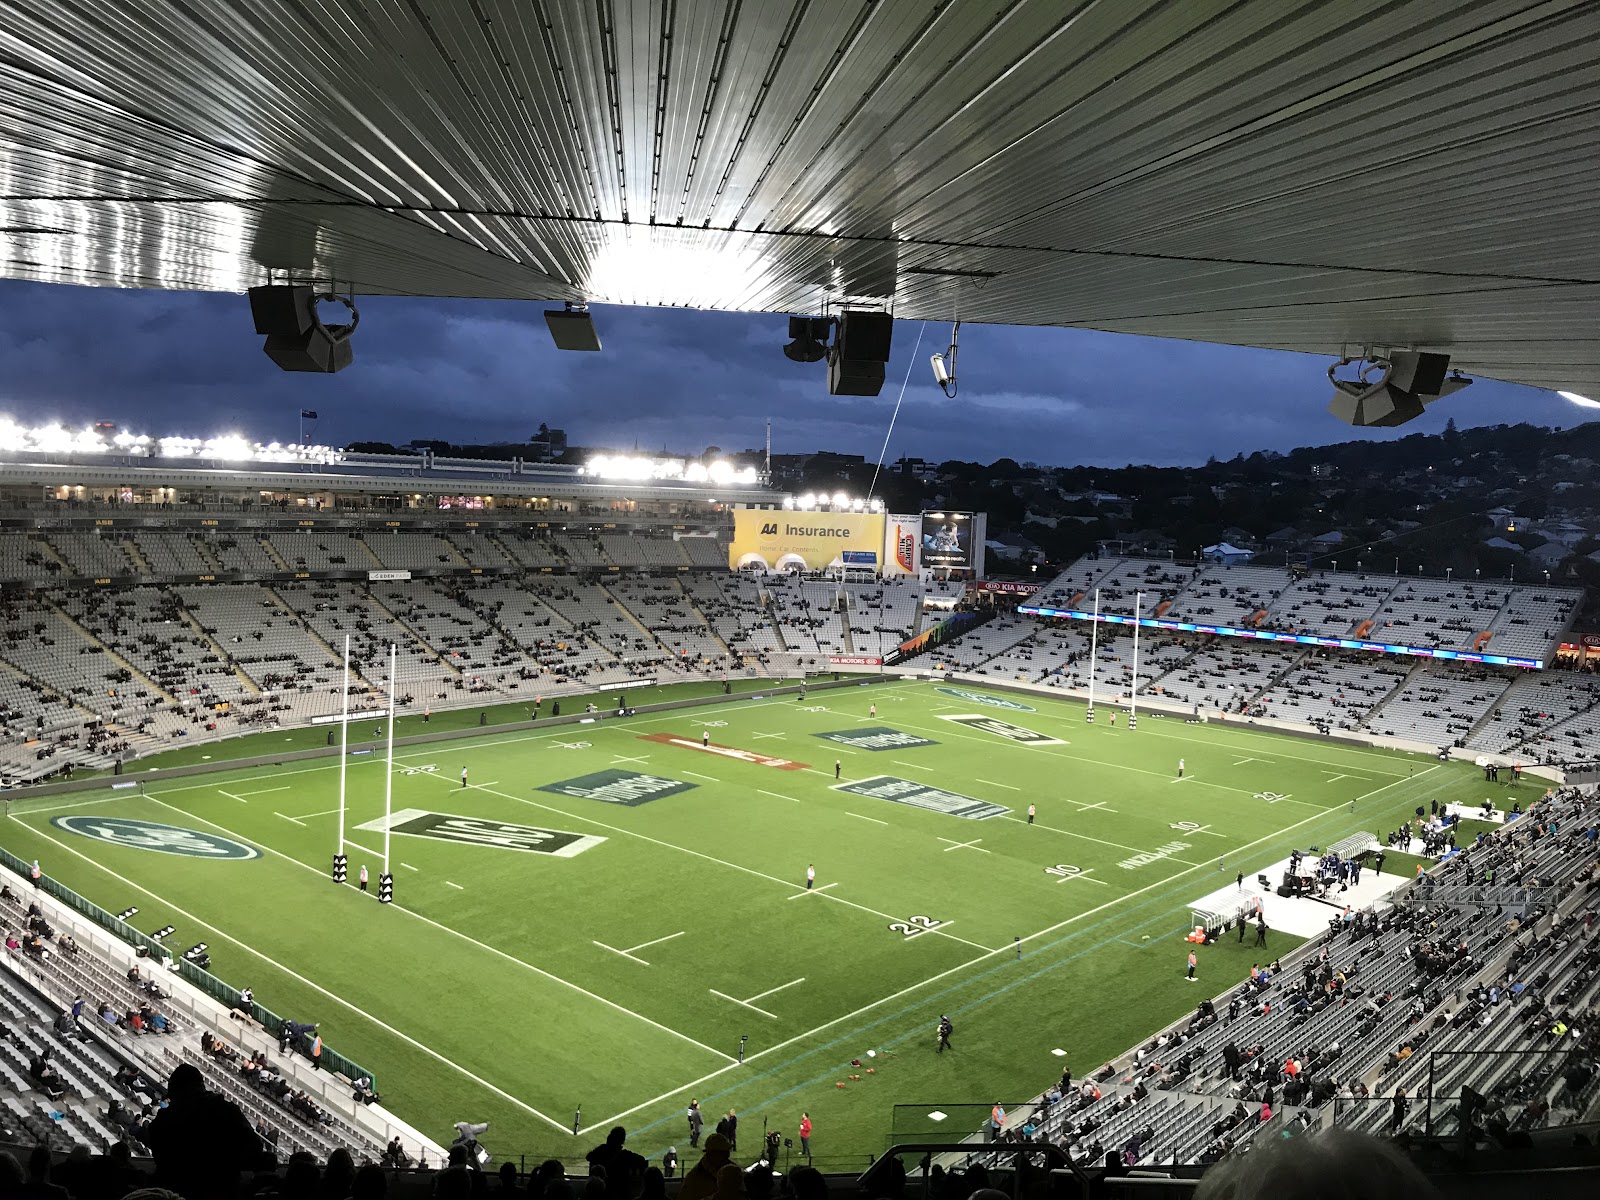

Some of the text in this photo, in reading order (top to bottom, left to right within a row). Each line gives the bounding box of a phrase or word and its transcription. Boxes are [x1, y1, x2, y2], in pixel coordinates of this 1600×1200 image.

[761, 523, 850, 537] AA Insurance
[1252, 791, 1283, 801] 22
[1169, 821, 1200, 831] 10
[426, 820, 554, 849] AIG
[1044, 864, 1083, 877] 10
[888, 915, 940, 935] 22
